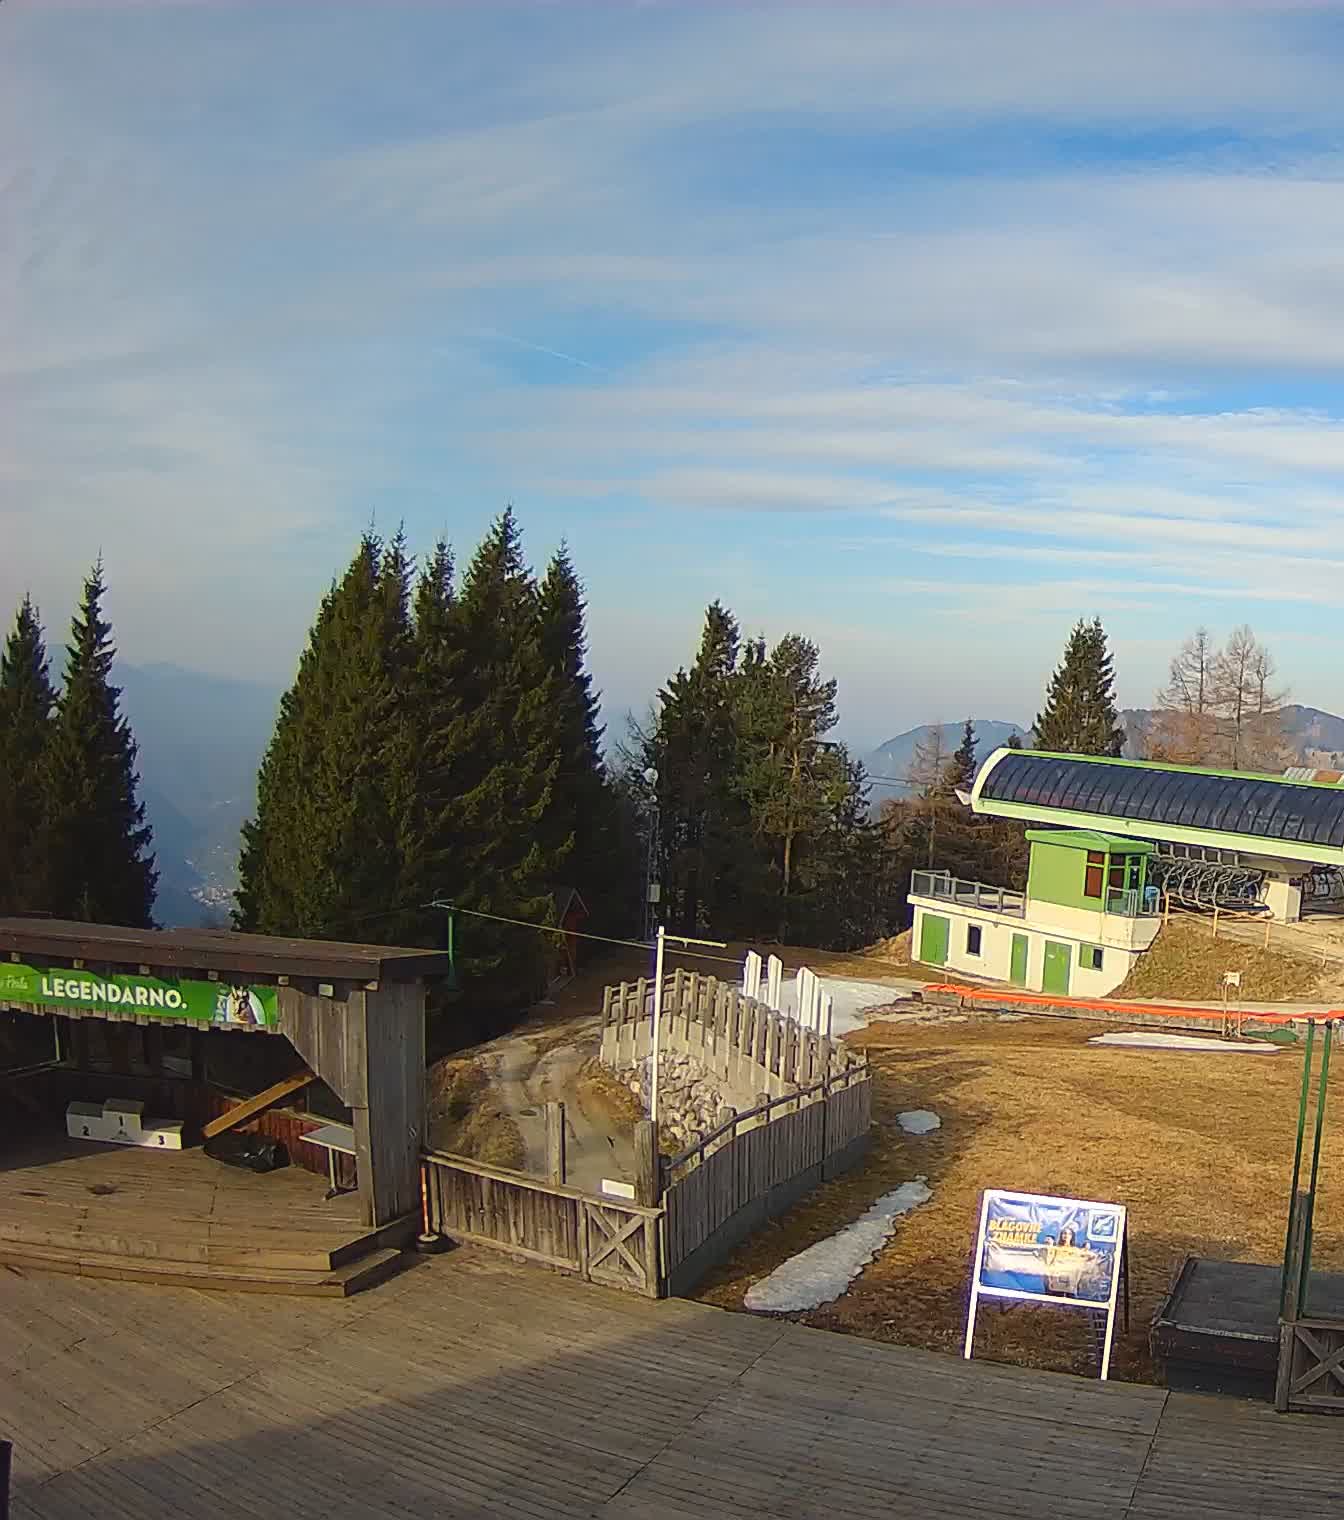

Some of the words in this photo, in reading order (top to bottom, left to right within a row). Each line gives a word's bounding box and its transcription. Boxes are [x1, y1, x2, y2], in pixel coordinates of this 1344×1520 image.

[41, 976, 188, 1010] LEGENDARNO.
[82, 1125, 90, 1137] 2
[158, 1135, 165, 1145] 3
